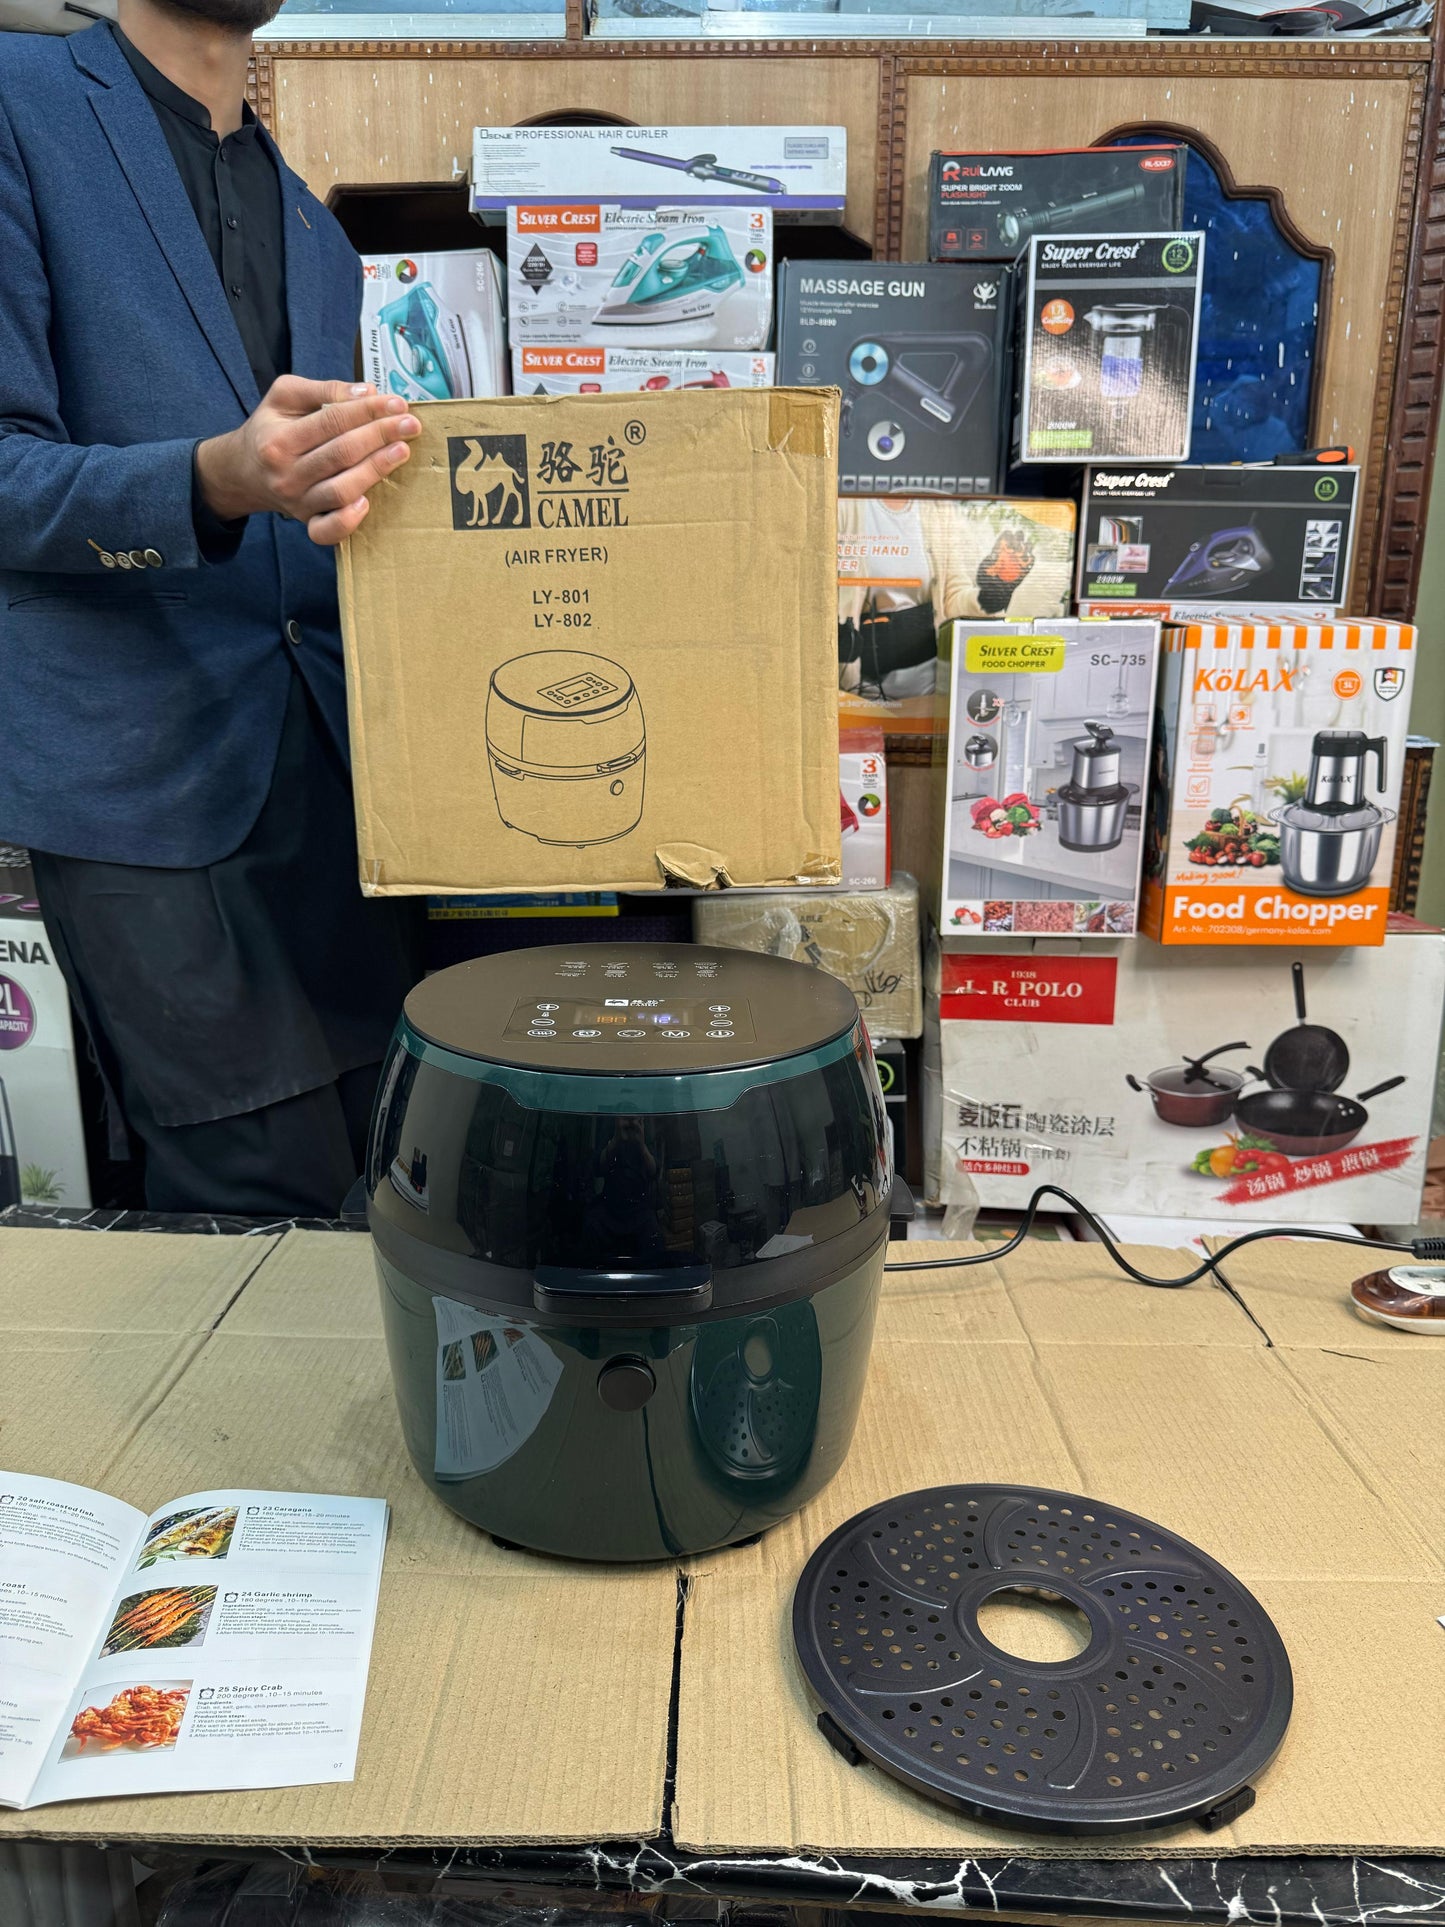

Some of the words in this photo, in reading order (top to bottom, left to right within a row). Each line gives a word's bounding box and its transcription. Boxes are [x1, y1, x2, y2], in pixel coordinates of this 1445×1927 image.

[515, 130, 595, 140] PROFESSIONAL
[599, 130, 622, 140] HAIR
[625, 129, 668, 140] CURLER
[940, 184, 968, 192] SUPER
[968, 184, 998, 192] BRIGHT
[998, 184, 1022, 192] ZOOM
[519, 212, 559, 226] SILVER
[560, 212, 598, 225] CREST
[604, 212, 646, 224] Electric
[682, 213, 705, 224] Iron
[750, 213, 764, 228] 3
[1042, 242, 1094, 264] Super
[1095, 242, 1139, 260] Crest
[800, 279, 885, 296] MASSAGE
[888, 282, 926, 298] GUN
[524, 354, 563, 367] SILVER
[565, 353, 602, 366] CREST
[608, 355, 648, 366] Electric
[651, 356, 682, 368] Steam
[685, 358, 708, 368] Iron
[752, 358, 766, 374] 3
[536, 435, 630, 487] 骆驼
[1094, 472, 1136, 490] Super
[1135, 472, 1170, 488] Crest
[537, 498, 630, 529] CAMEL
[544, 546, 609, 565] FRYER)
[872, 546, 910, 556] HAND
[532, 589, 591, 605] LY-801
[534, 613, 593, 628] LY-802
[979, 644, 1018, 657] SILVER
[1020, 644, 1056, 657] CREST
[982, 660, 1006, 668] FOOD
[1007, 660, 1046, 668] CHOPPER
[1090, 654, 1147, 666] SC-735
[862, 758, 878, 774] 3
[848, 878, 878, 886] SC-266
[1172, 894, 1246, 920] Food
[1254, 895, 1379, 927] Chopper
[1020, 982, 1083, 998] POLO
[1004, 998, 1041, 1008] CLUB
[46, 1500, 79, 1512] roasted
[79, 1507, 95, 1517] fish
[40, 1592, 68, 1604] minutes
[232, 1685, 258, 1693] Spicy
[232, 1692, 264, 1700] degrees
